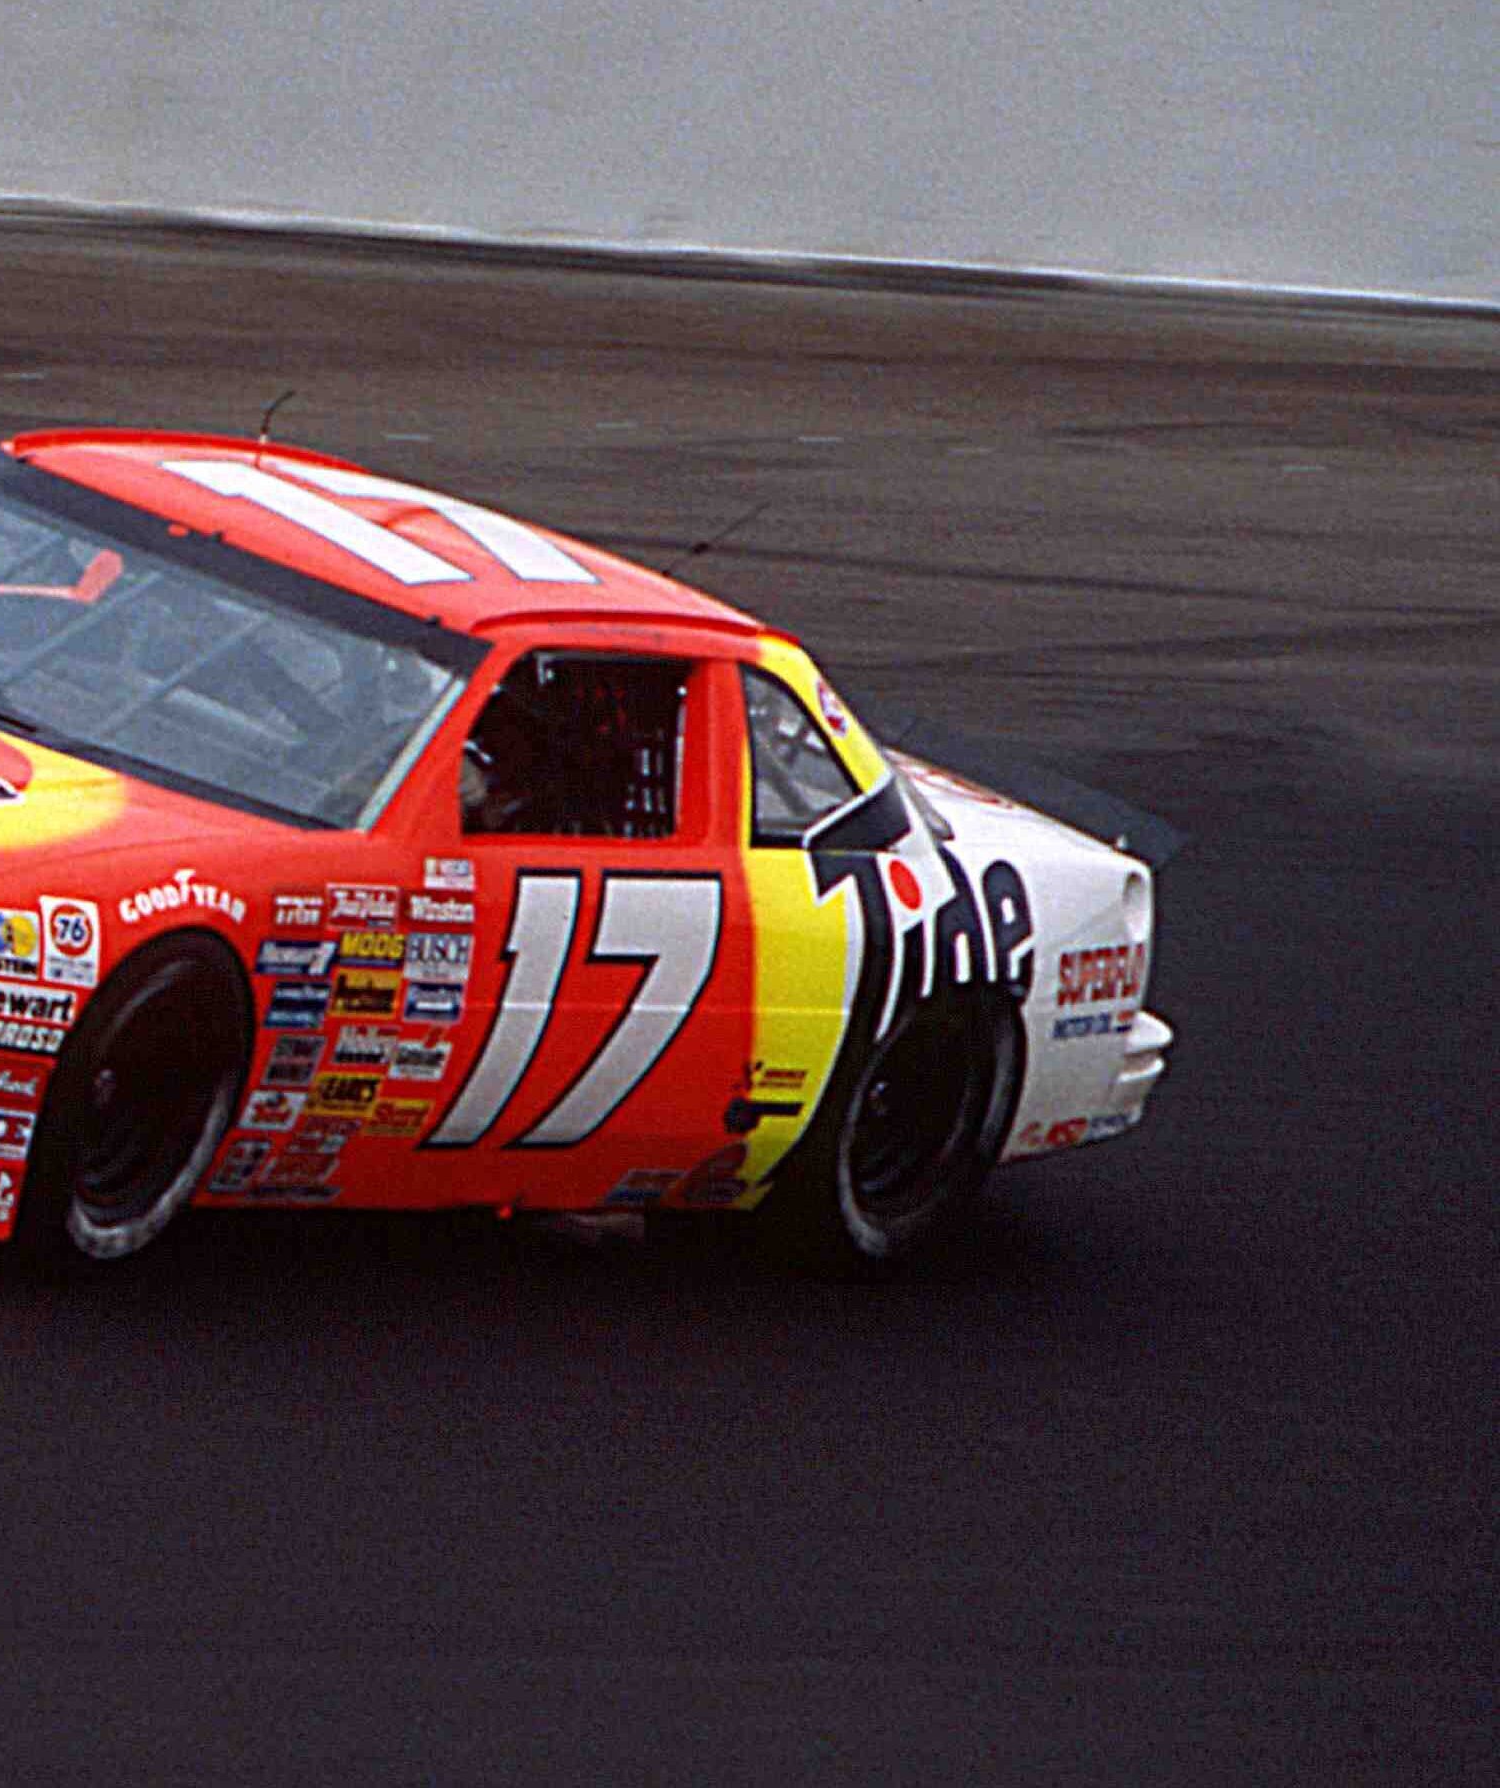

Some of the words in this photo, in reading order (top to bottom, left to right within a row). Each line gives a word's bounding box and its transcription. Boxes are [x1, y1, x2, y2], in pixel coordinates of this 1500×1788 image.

[155, 459, 602, 585] 17
[57, 916, 86, 942] 76
[341, 932, 404, 957] MOOG
[406, 934, 469, 962] BUSCH
[414, 866, 723, 1151] 17
